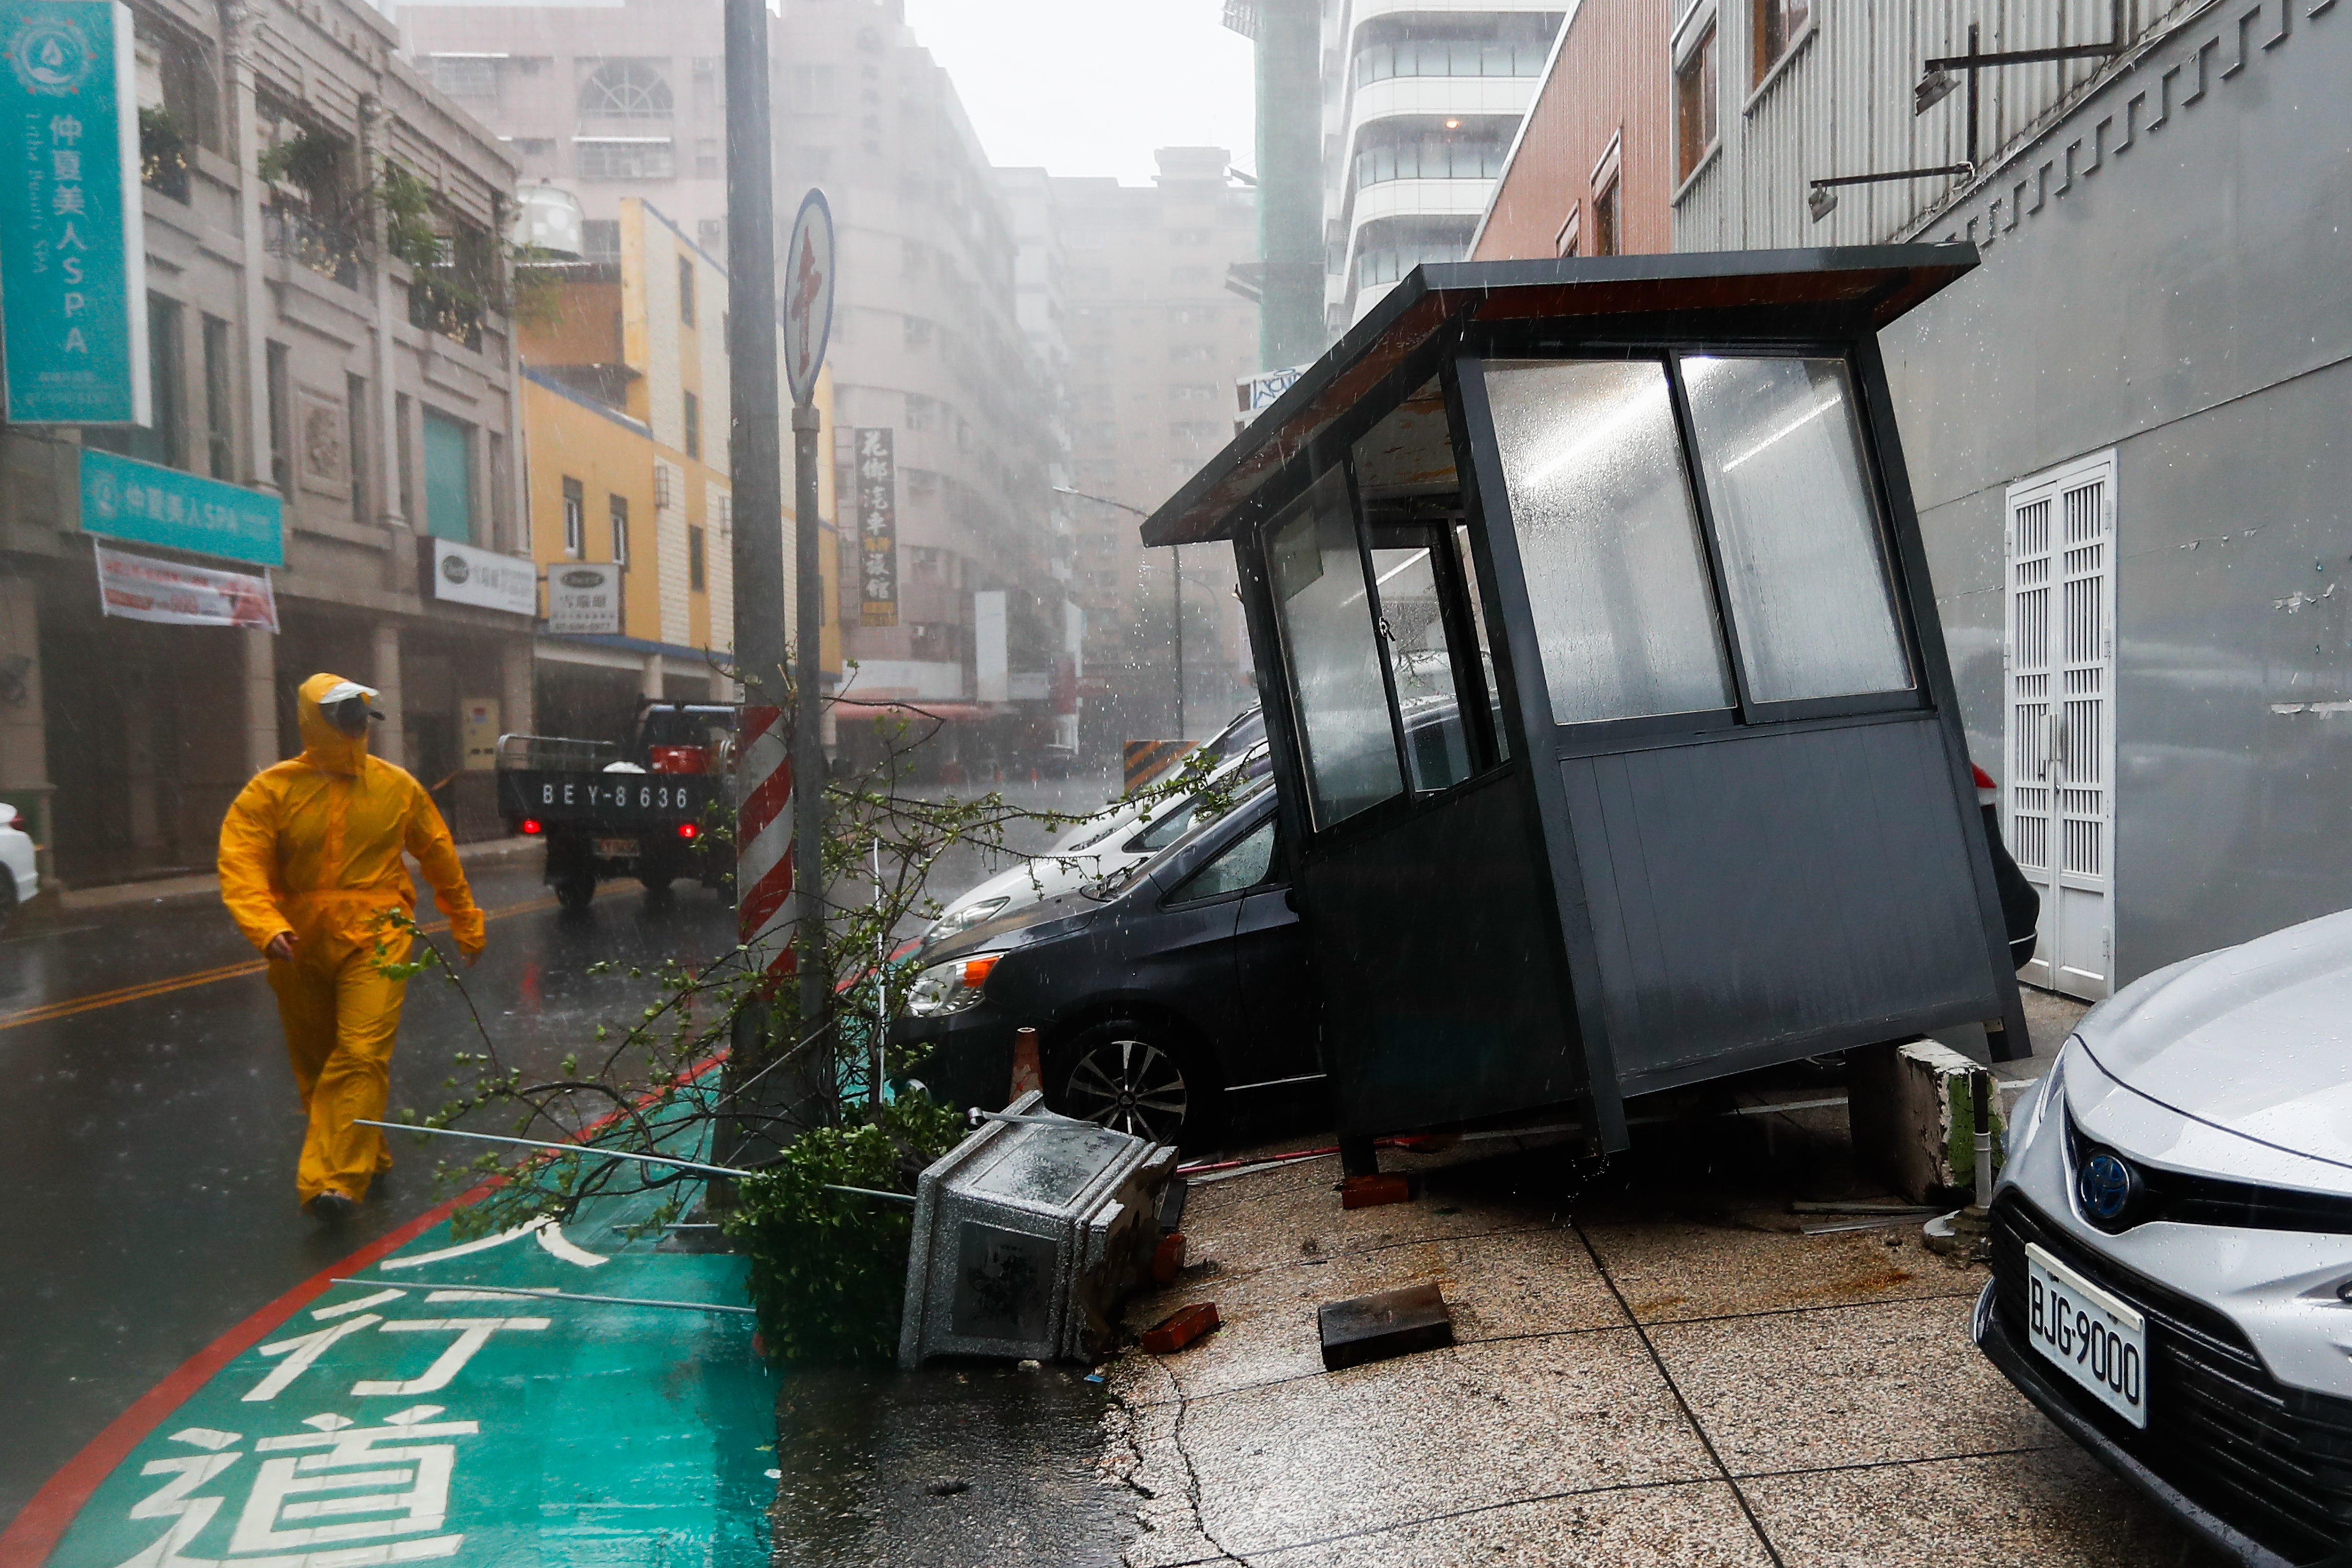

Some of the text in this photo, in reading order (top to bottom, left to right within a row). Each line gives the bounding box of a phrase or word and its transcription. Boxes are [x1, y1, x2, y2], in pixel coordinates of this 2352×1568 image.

[49, 114, 89, 354] 仲夏美人SPA
[542, 784, 687, 809] BEY-8636
[113, 1208, 610, 1568] 人行道
[2030, 1275, 2139, 1405] BJG-9000
